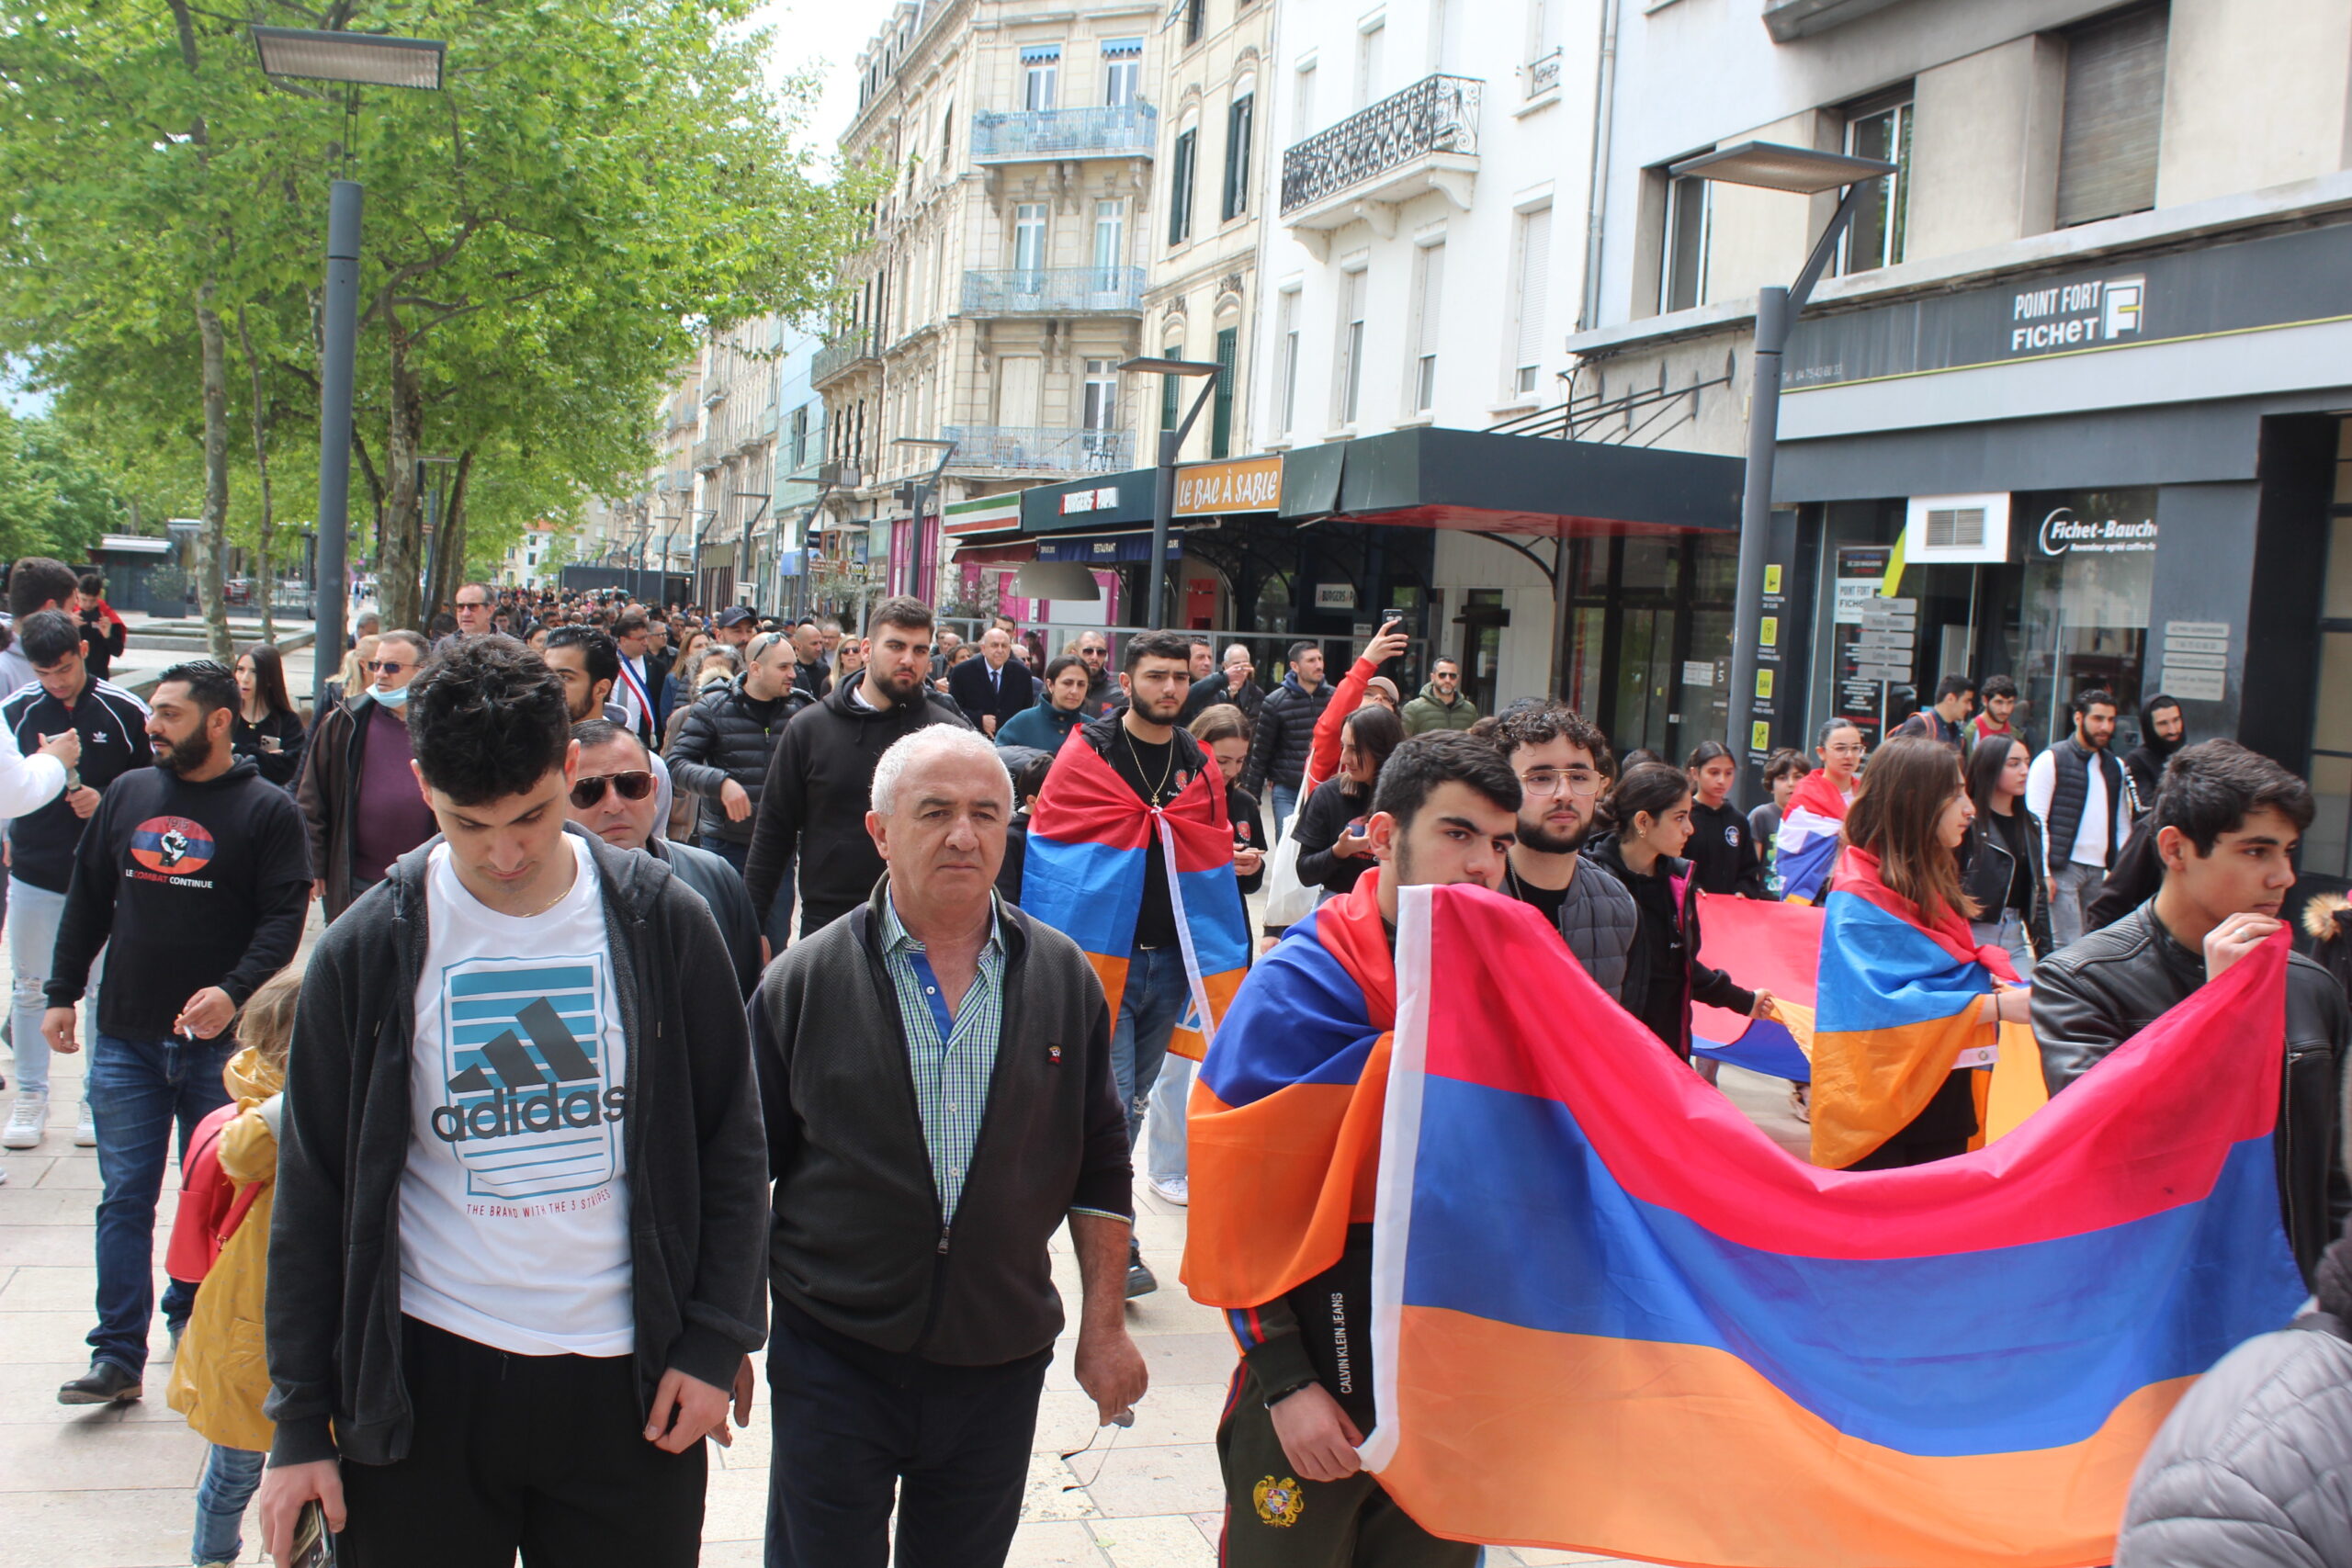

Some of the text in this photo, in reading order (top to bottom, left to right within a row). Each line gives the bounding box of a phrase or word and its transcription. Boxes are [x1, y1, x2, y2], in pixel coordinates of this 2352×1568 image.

[2014, 279, 2103, 321] POINT FORT
[1179, 468, 1278, 510] LE BAC À SABLE
[1093, 542, 1116, 553] RESTAURANT
[1840, 585, 1871, 596] POINT FORT
[1717, 669, 1725, 682] 5
[125, 868, 213, 889] LE COMBAT CONTINUE
[431, 1084, 626, 1143] adidas
[466, 1188, 612, 1219] THE BRAND WITH THE 3 STRIPES
[1330, 1292, 1353, 1394] CALVIN KLEIN JEANS
